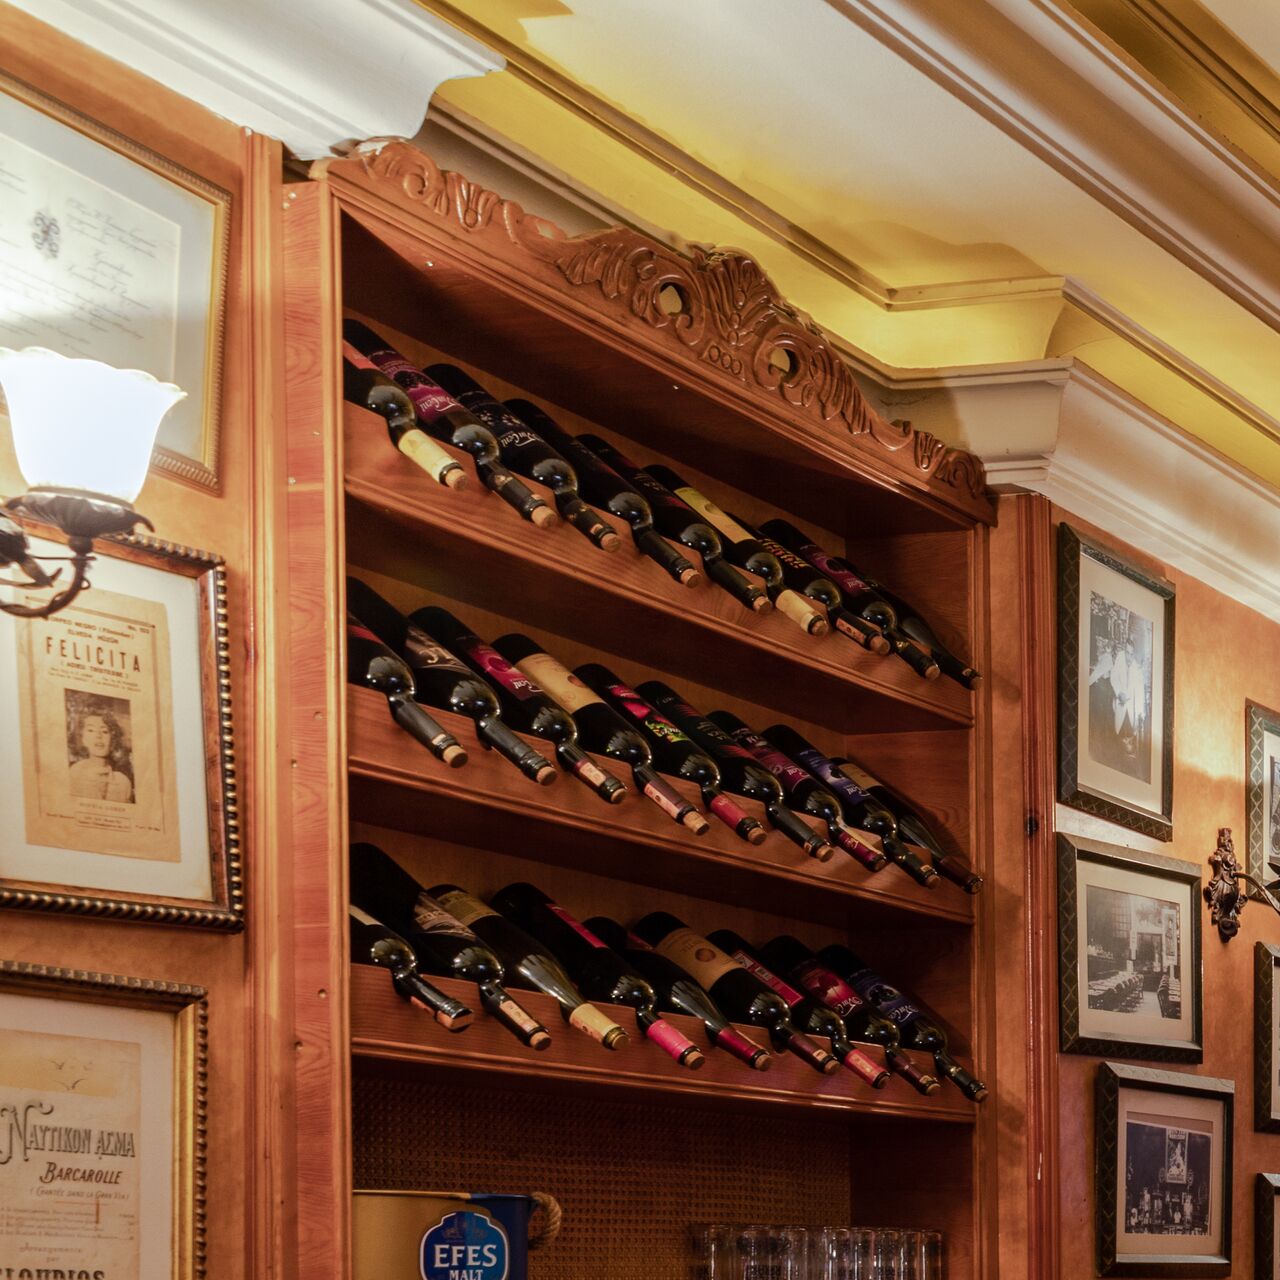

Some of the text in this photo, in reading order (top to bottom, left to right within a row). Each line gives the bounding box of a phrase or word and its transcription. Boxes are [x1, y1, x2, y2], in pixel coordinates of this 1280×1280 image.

[46, 635, 142, 674] FELICITA
[39, 1161, 123, 1185] BARCAROLLE
[433, 1243, 497, 1269] EFES
